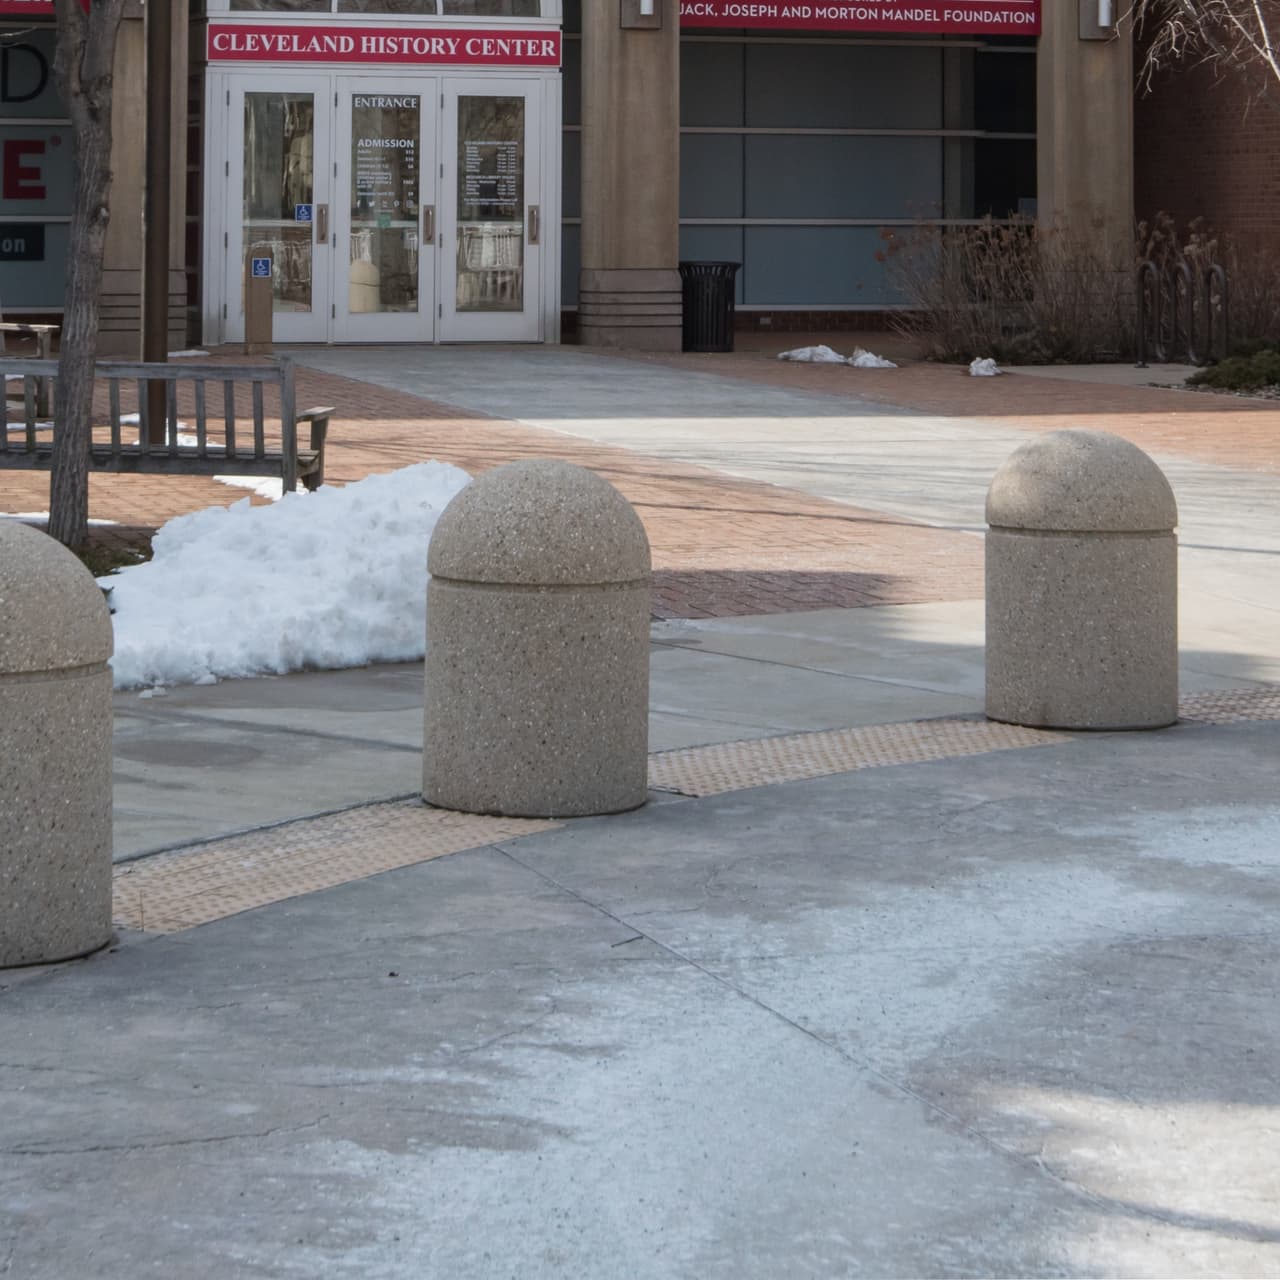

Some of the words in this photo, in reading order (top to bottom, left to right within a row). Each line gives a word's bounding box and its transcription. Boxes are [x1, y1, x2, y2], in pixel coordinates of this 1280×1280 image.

[680, 3, 718, 16] JACK,
[722, 4, 777, 17] JOSEPH
[781, 6, 811, 19] AND
[815, 7, 878, 20] MORTON
[881, 9, 940, 22] MANDEL
[943, 10, 1036, 24] FOUNDATION
[213, 32, 355, 53] CLEVELAND
[360, 35, 461, 55] HISTORY
[465, 37, 557, 57] CENTER
[354, 97, 417, 109] ENTRANCE
[358, 138, 415, 149] ADMISSION
